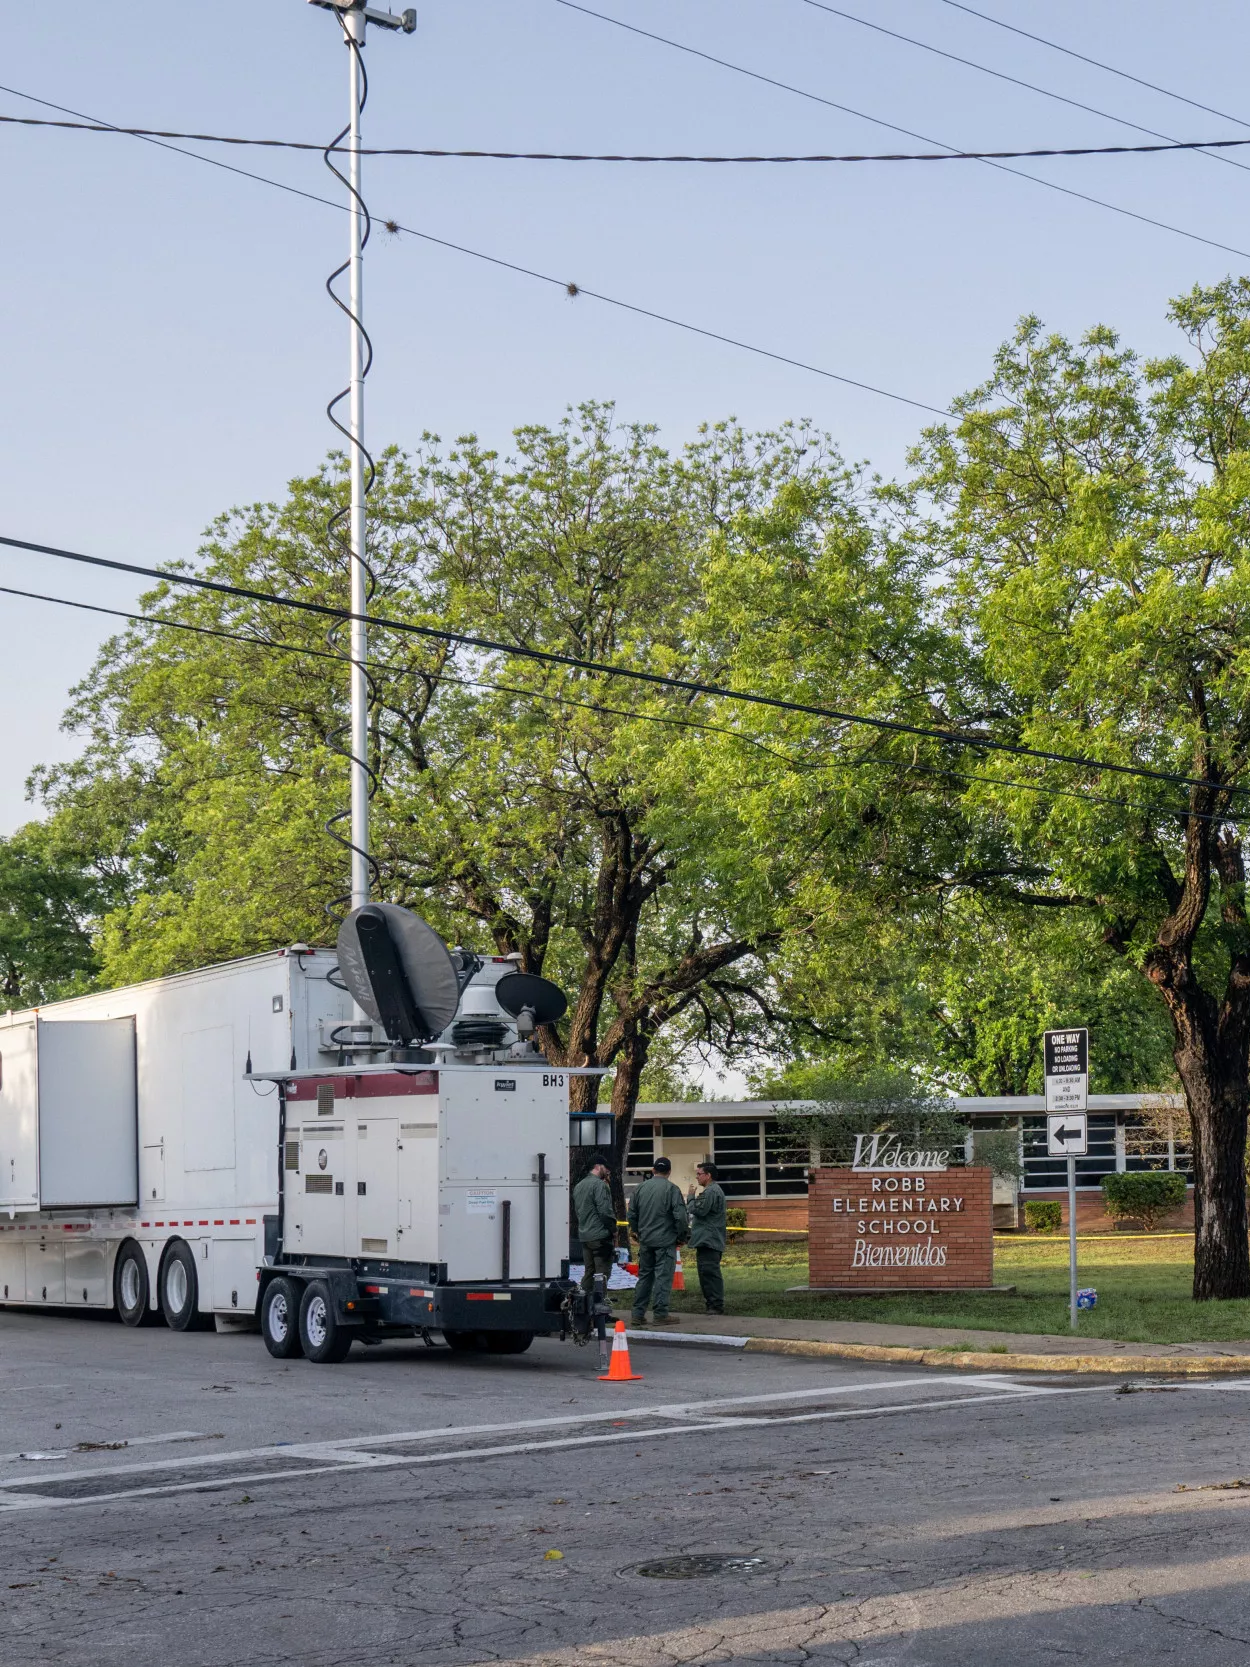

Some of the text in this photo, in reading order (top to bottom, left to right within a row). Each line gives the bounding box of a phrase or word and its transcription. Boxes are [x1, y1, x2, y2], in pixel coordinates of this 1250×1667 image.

[1051, 1033, 1080, 1045] ONE WAY
[1061, 1045, 1078, 1053] PARKING
[1061, 1055, 1078, 1063] LOADING
[1052, 1064, 1081, 1073] OR UNLOADING
[542, 1074, 564, 1087] BH3
[852, 1134, 949, 1169] Welcome
[872, 1177, 926, 1192] ROBB
[833, 1197, 964, 1213] ELEMENTARY
[857, 1220, 940, 1234] SCHOOL
[851, 1237, 948, 1267] Bienvenidos
